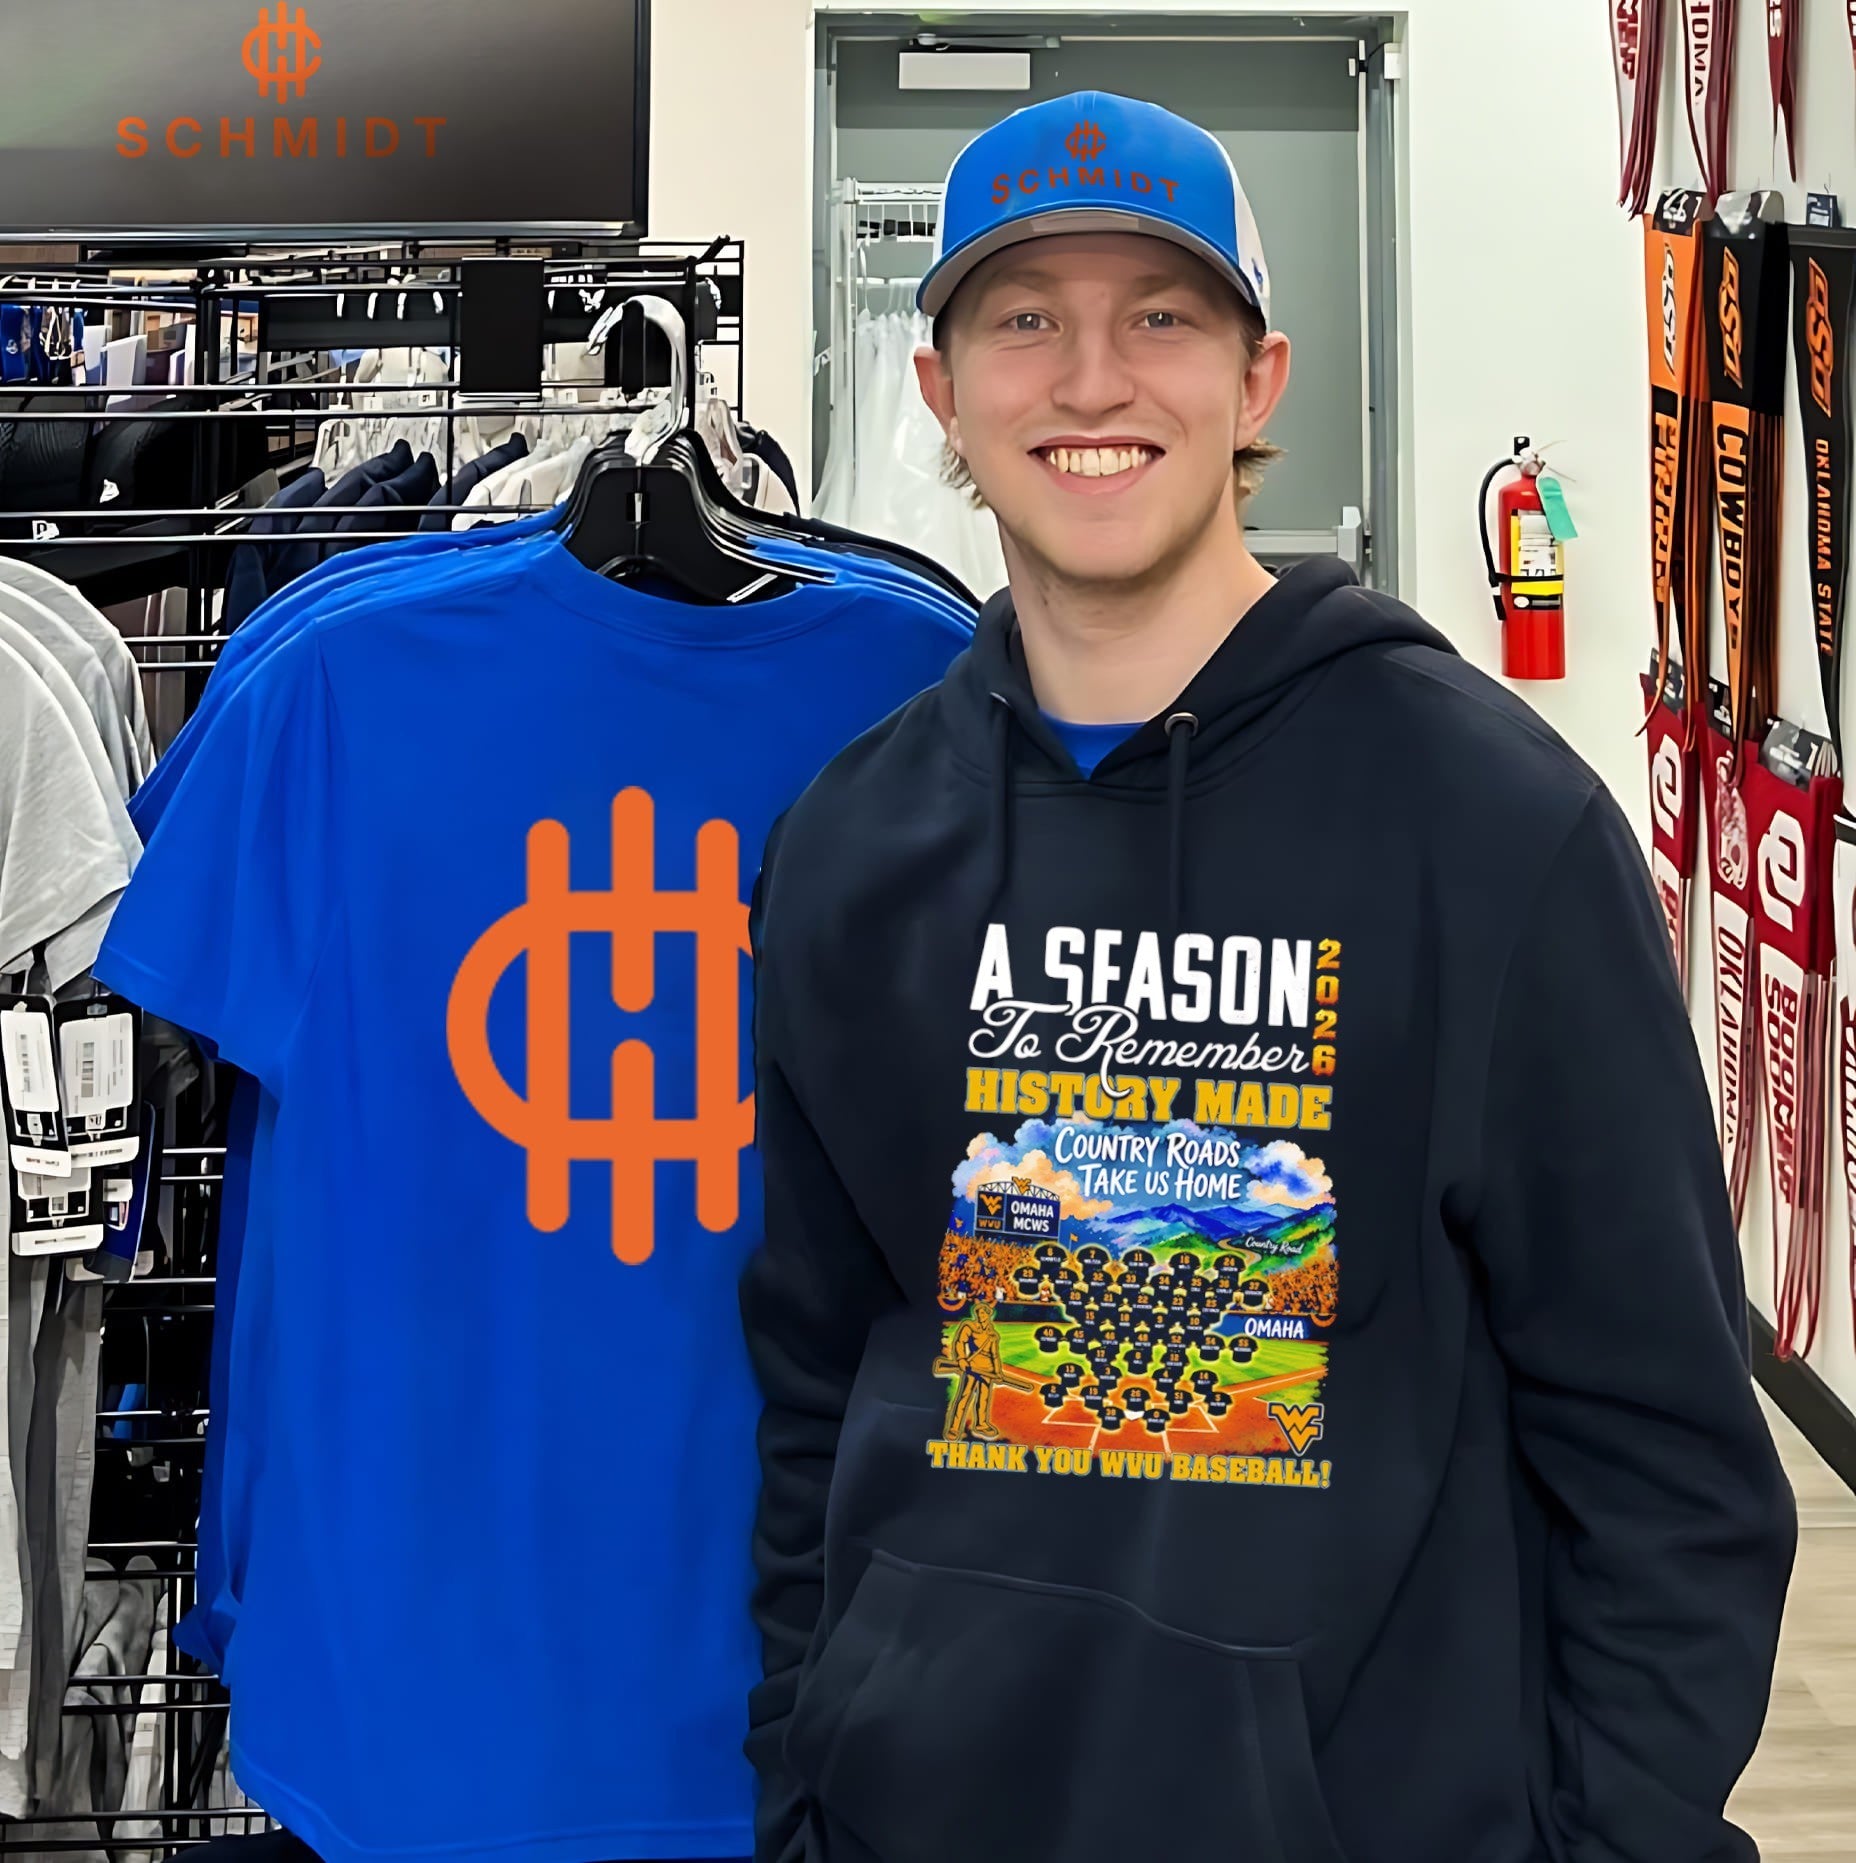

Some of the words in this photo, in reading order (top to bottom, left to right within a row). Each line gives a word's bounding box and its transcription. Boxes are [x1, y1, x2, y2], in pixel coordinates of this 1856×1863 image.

[116, 116, 447, 158] SCHMIDT
[991, 166, 1179, 204] SCHMIDT
[1815, 437, 1832, 570] OKLAHOMA
[969, 923, 1014, 1011] A
[1044, 926, 1312, 1028] SEASON
[968, 999, 1076, 1059] To
[1055, 1004, 1311, 1098] Remember
[1717, 924, 1746, 1144] OKLAHOMA
[964, 1066, 1182, 1123] HISTORY
[1194, 1079, 1333, 1131] MADE
[1055, 1126, 1160, 1168] COUNTRY
[1167, 1132, 1242, 1170] ROADS
[1077, 1163, 1139, 1198] TAKE
[1144, 1169, 1170, 1197] US
[1175, 1166, 1243, 1202] HOME
[1010, 1200, 1054, 1218] OMAHA
[1013, 1216, 1050, 1233] MCWS
[1245, 1235, 1279, 1255] Country
[1279, 1241, 1305, 1254] Road
[1244, 1317, 1305, 1340] OMAHA
[926, 1439, 1029, 1473] THANK
[1034, 1445, 1092, 1476] YOU
[1100, 1450, 1166, 1480] WVU
[1172, 1453, 1333, 1489] BASEBALL!
